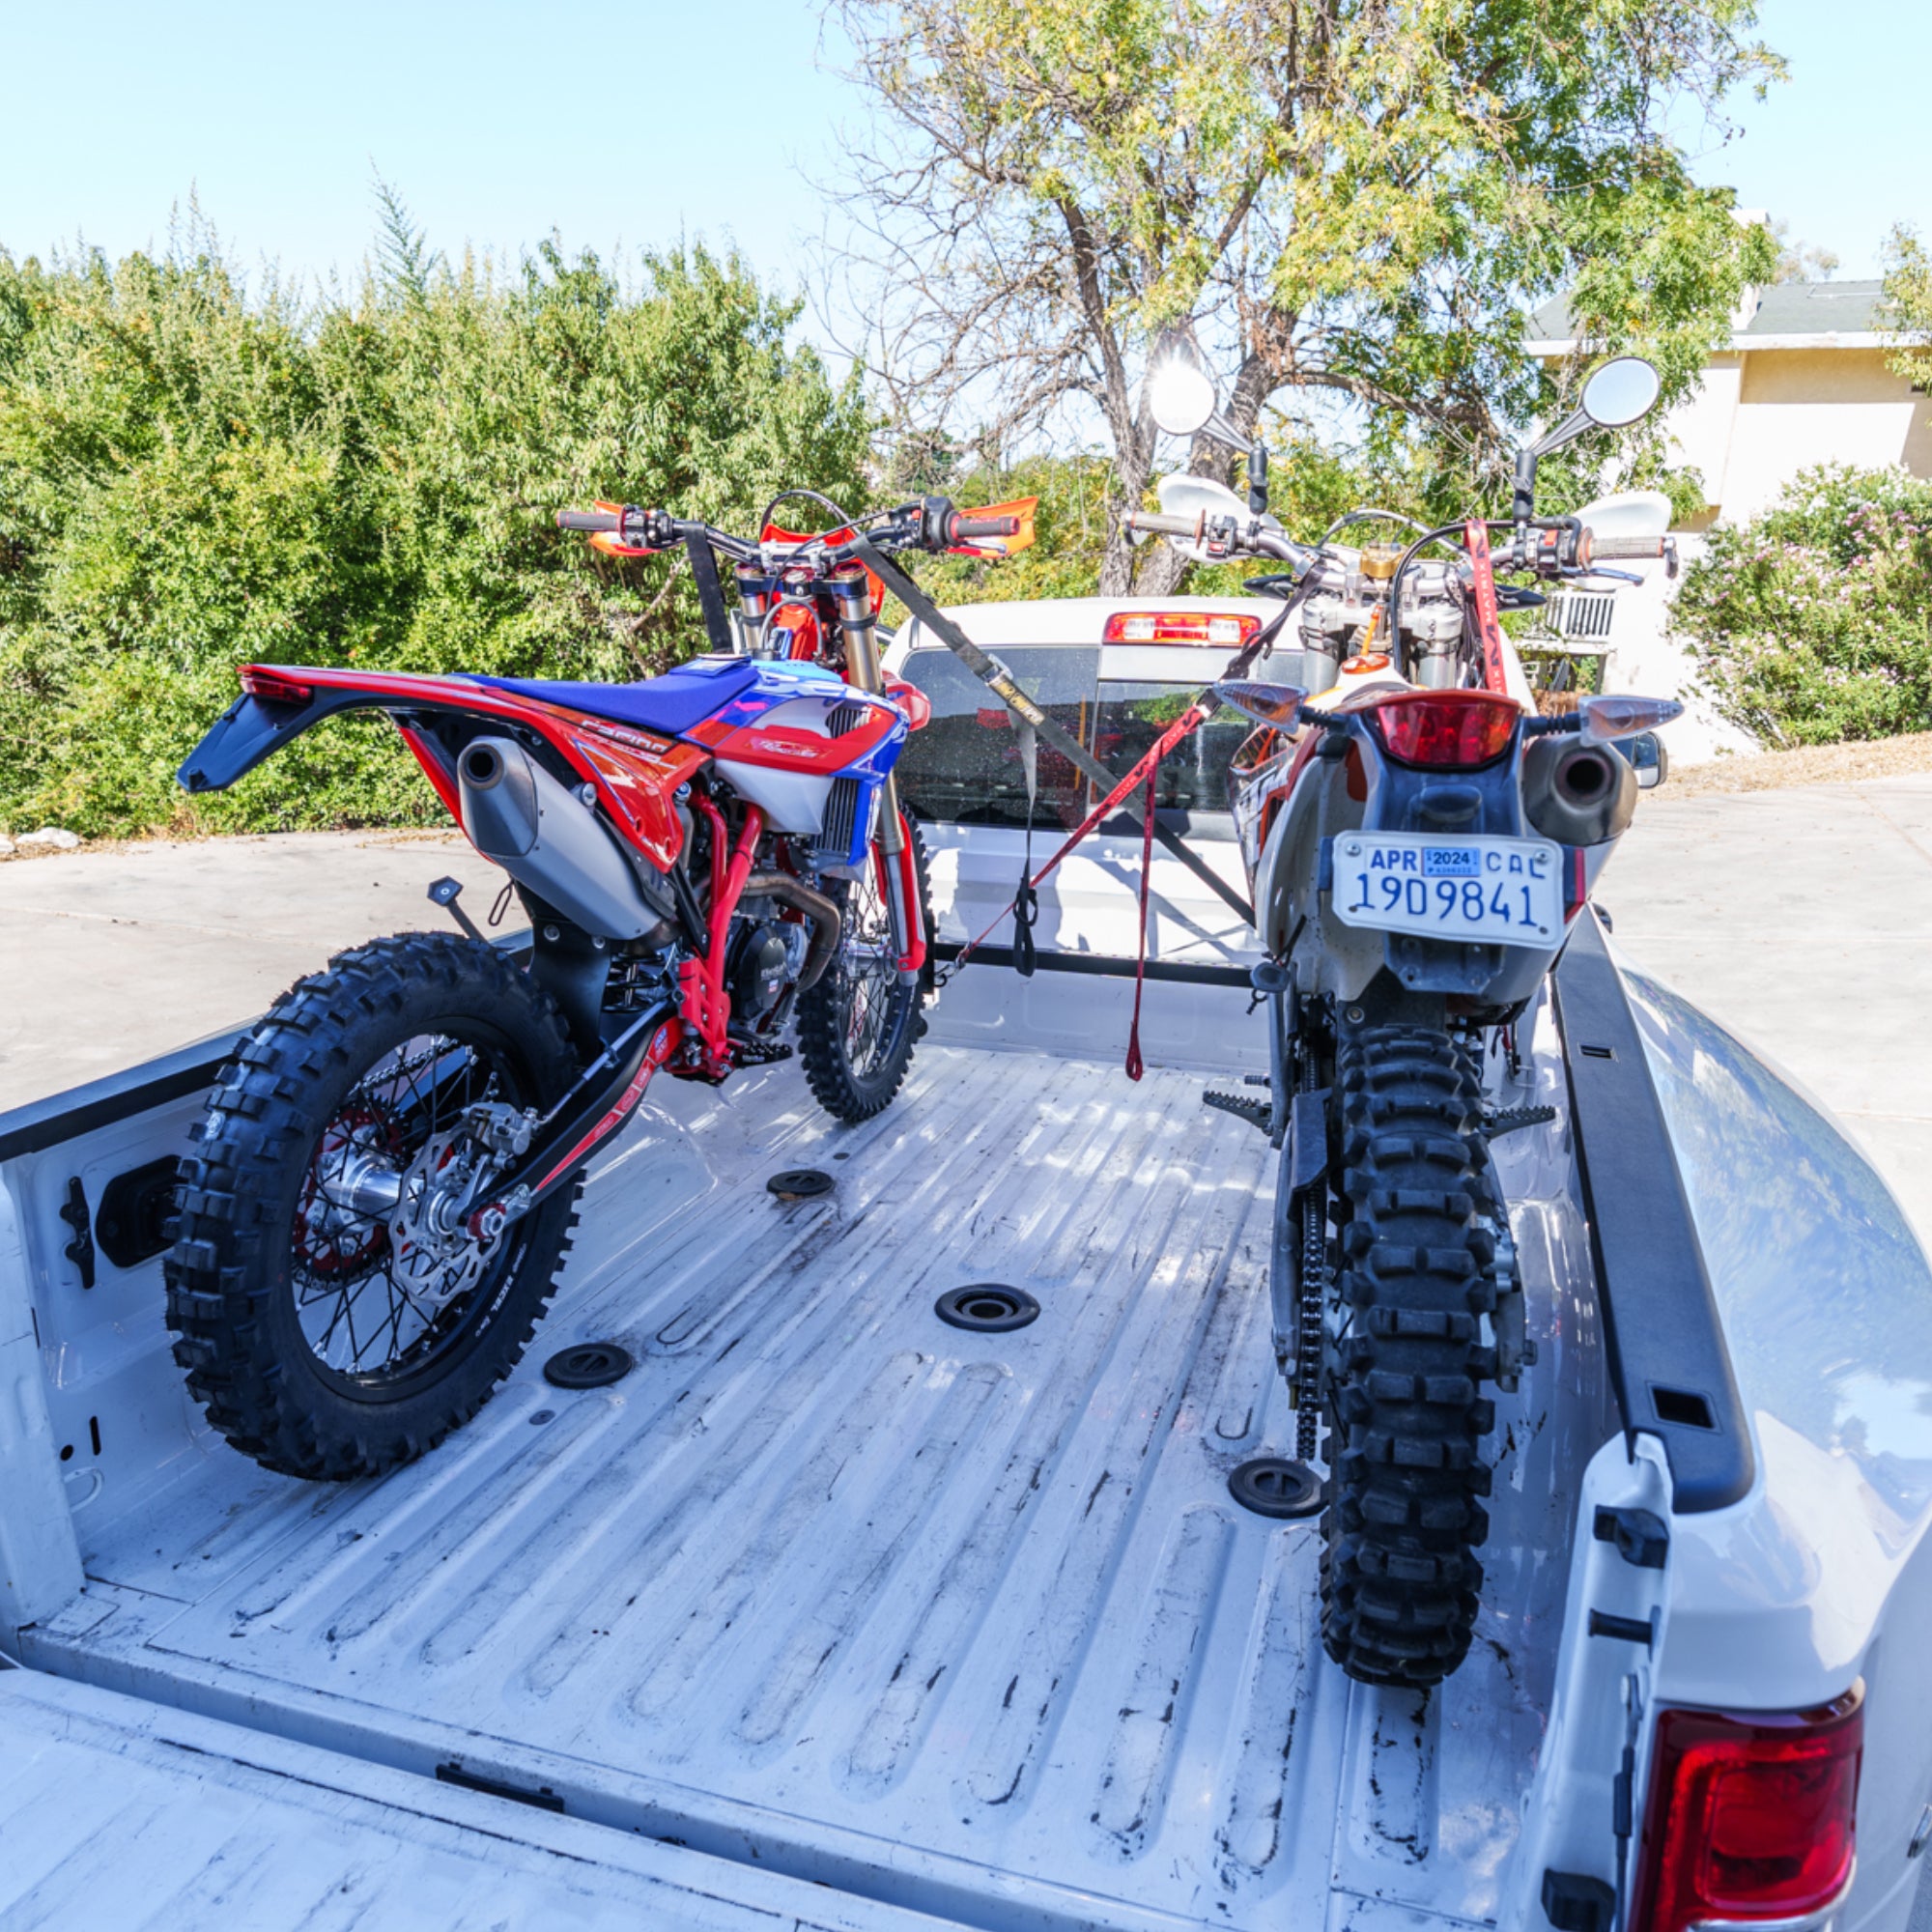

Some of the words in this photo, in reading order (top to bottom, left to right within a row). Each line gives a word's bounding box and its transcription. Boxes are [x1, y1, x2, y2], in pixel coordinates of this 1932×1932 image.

[1479, 562, 1492, 623] MATRIX
[1370, 849, 1417, 871] APR
[1433, 851, 1470, 865] 2024
[1486, 851, 1546, 880] CAL
[1354, 873, 1538, 927] 19D9841
[491, 1275, 514, 1312] EXCEL
